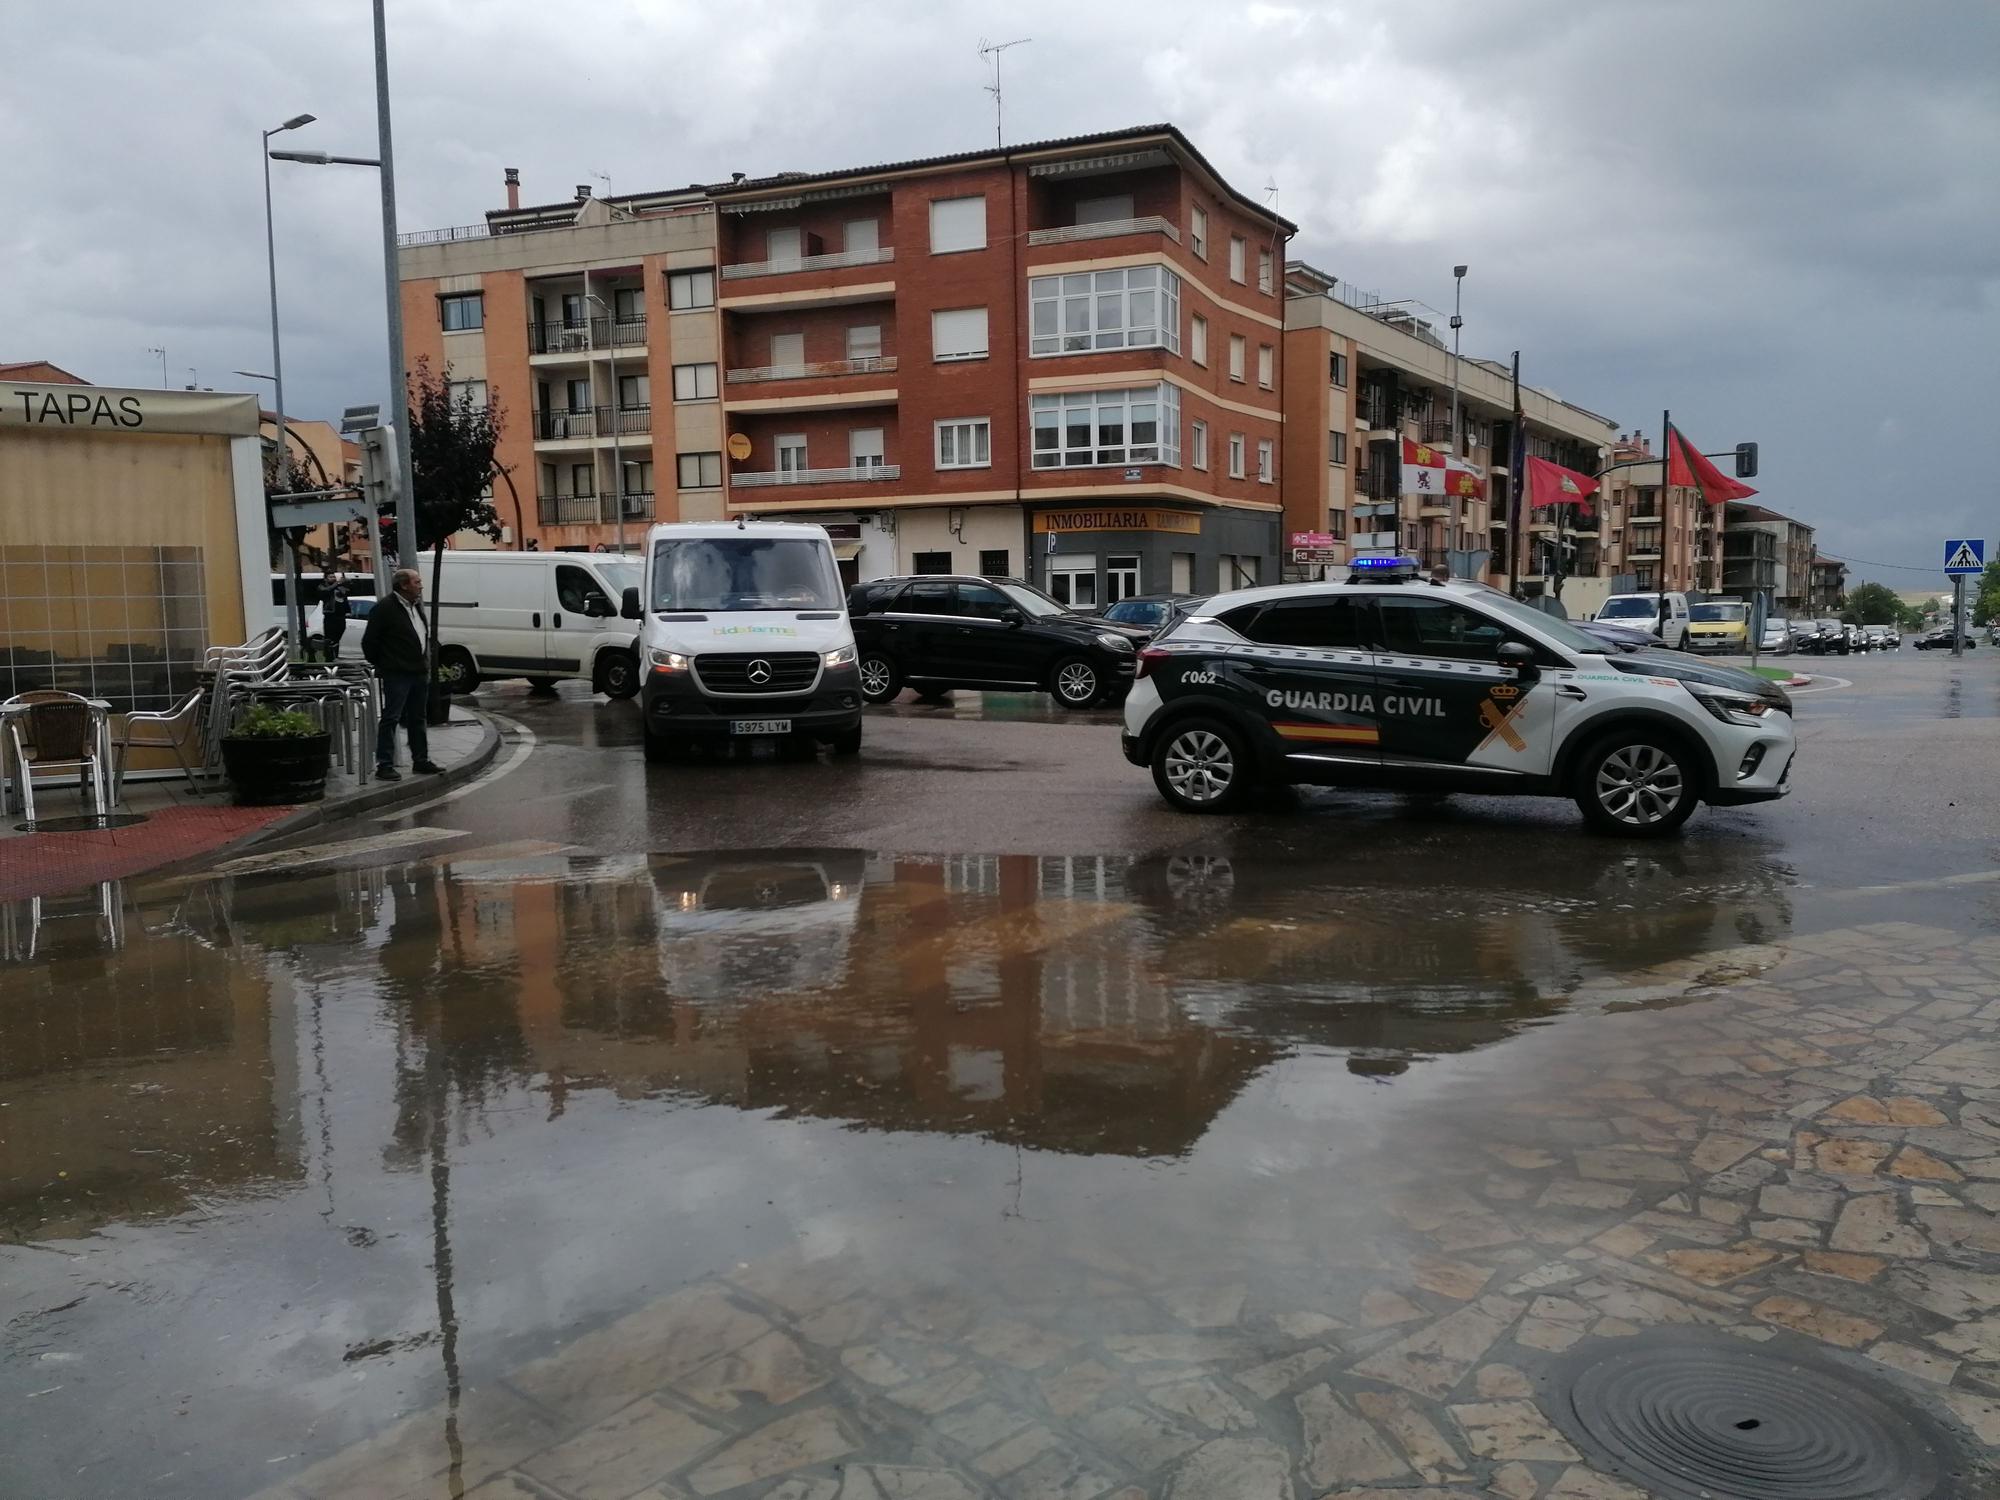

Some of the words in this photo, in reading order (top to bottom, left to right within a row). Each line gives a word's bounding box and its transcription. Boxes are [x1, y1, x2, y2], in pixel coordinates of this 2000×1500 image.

[14, 391, 143, 427] TAPAS
[1046, 512, 1148, 529] INMOBILIARIA
[1190, 671, 1217, 684] 062
[1577, 674, 1619, 682] GUARDIA
[1621, 676, 1645, 684] CIVIL
[1266, 689, 1376, 712] GUARDIA
[1383, 695, 1446, 717] CIVIL
[737, 722, 765, 732] 5975
[767, 721, 789, 732] LYM
